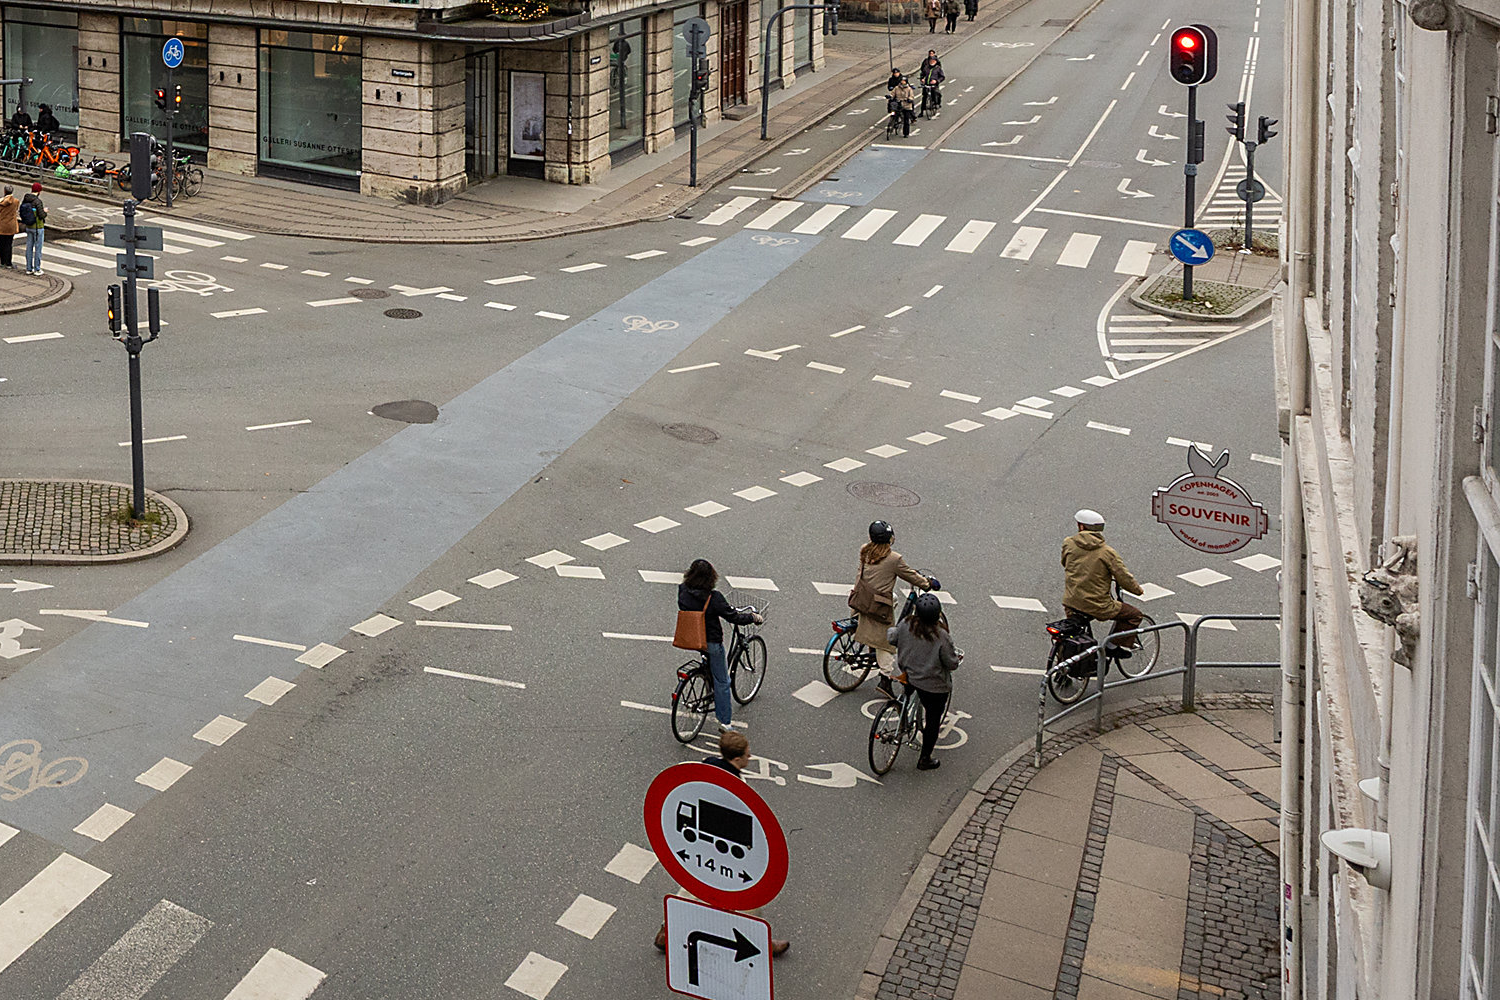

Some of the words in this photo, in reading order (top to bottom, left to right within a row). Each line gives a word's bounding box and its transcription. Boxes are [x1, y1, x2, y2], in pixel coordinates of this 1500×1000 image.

[125, 115, 150, 125] GALLERI
[151, 119, 179, 129] SUSANE
[293, 141, 326, 151] SUSANNE
[327, 145, 360, 155] OTTESEN
[1180, 481, 1238, 500] COPENHAGEN
[1169, 504, 1250, 526] SOUVENIR
[1180, 529, 1198, 544] world
[1207, 538, 1240, 549] memories
[695, 854, 716, 873] 14
[720, 864, 734, 878] m
